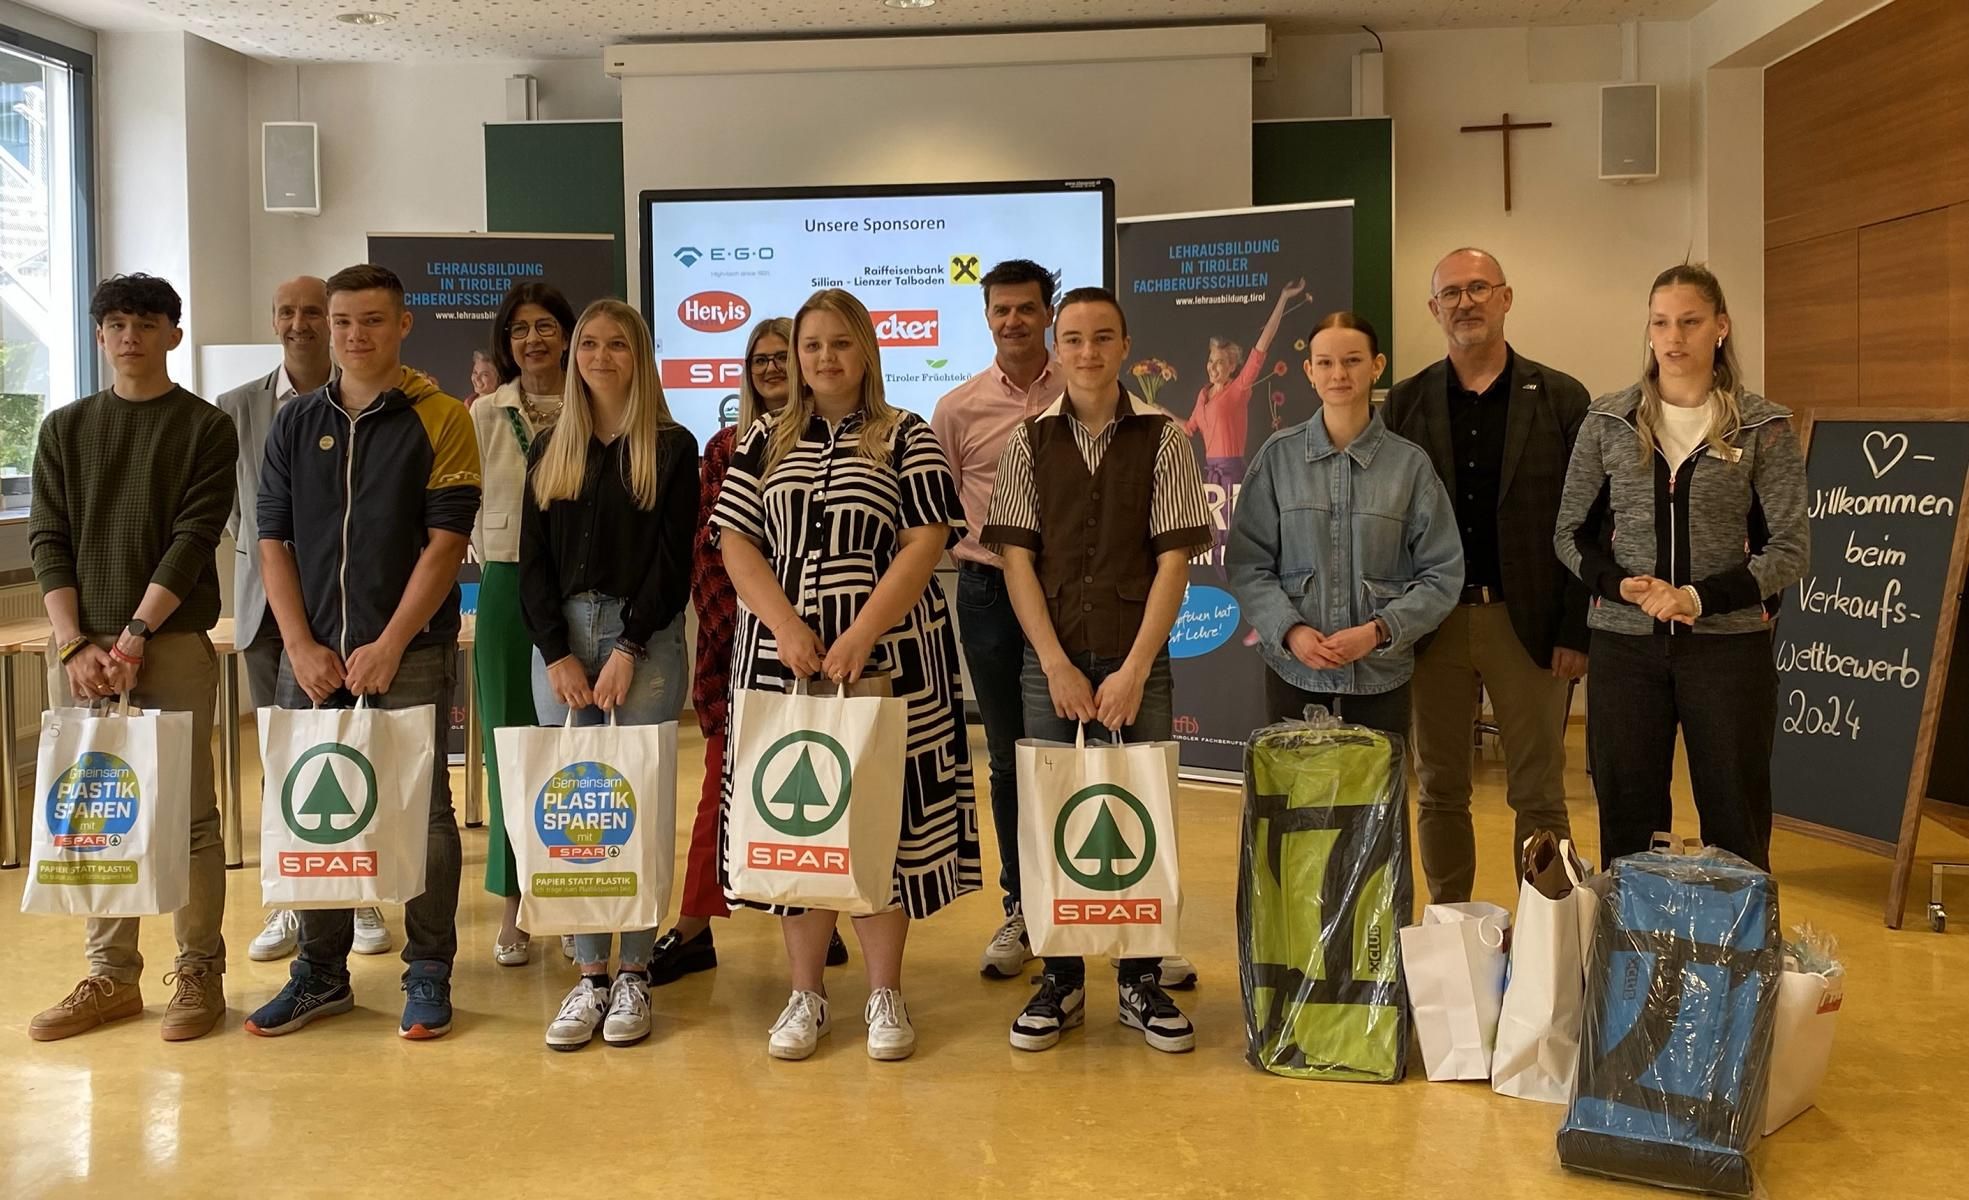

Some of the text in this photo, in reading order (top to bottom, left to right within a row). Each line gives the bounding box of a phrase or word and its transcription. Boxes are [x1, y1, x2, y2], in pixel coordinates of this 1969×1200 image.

[805, 217, 945, 234] Unsere Sponsoren
[1169, 239, 1280, 259] LEHRAUSBILDUNG
[426, 262, 543, 276] LEHRAUSBILDUNG
[864, 265, 945, 276] Raiffeisenbank
[1181, 257, 1248, 274] IN TIROLER
[440, 278, 512, 291] IN TIROLER
[811, 277, 843, 287] Sillian
[854, 277, 892, 287] Lienzer
[895, 275, 945, 286] Talboden
[1133, 272, 1268, 293] FACHBERUFSSCHULEN
[1175, 292, 1265, 305] www.lehrausbildung.tirol
[685, 300, 746, 325] Hervis
[876, 313, 938, 340] cker
[885, 374, 920, 382] Tiroler
[1845, 531, 1905, 567] beim
[1799, 577, 1921, 628] Verkaufs-
[1776, 640, 1920, 689] Wettbewerb
[1783, 689, 1860, 740] 2024
[50, 723, 61, 738] 5
[1044, 754, 1054, 771] 4
[552, 777, 622, 789] Gemeinsam
[543, 791, 630, 810] PLASTIK
[80, 821, 96, 830] mit
[543, 812, 627, 830] SPAREN
[62, 836, 106, 845] SPAR
[577, 832, 593, 842] mit
[559, 847, 605, 857] SPAR
[751, 847, 845, 870] SPAR
[71, 864, 96, 874] STATT
[98, 865, 132, 873] PLASTIK
[282, 856, 373, 873] SPAR
[536, 876, 631, 886] PAPIER STATT PLASTIK
[1058, 903, 1157, 921] SPAR
